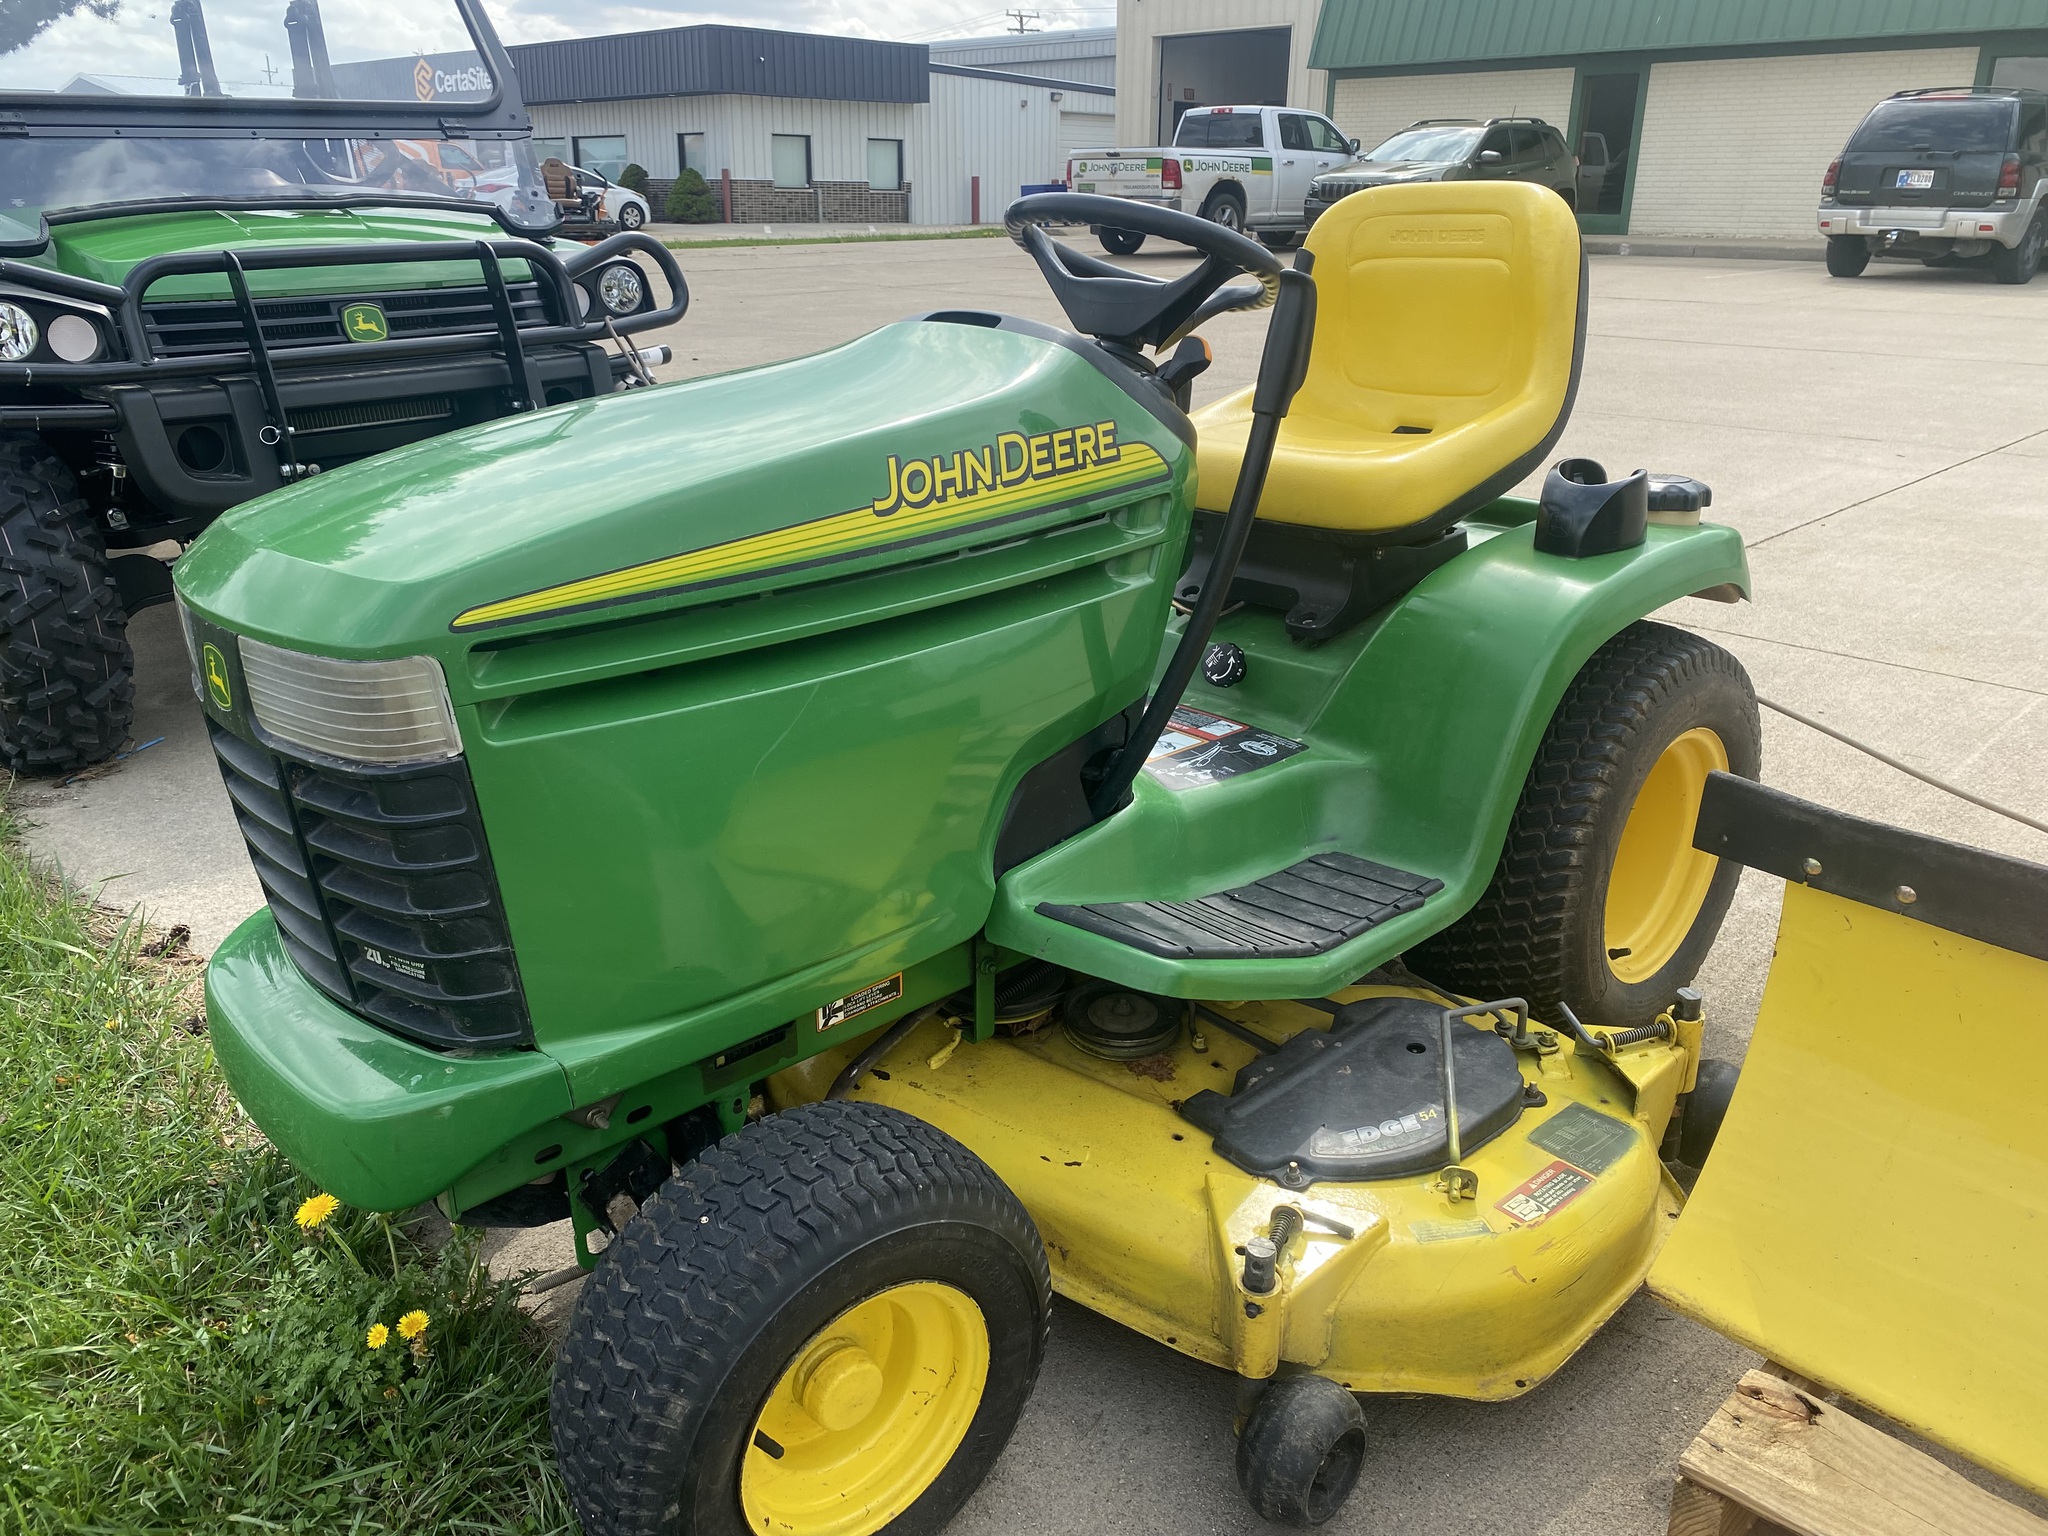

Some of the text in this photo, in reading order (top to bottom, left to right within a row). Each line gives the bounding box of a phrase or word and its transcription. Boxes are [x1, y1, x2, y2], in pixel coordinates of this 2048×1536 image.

[435, 66, 492, 93] CertaSite
[1088, 162, 1146, 172] JOHN DEERE
[1195, 160, 1250, 173] JOHN DEERE
[1389, 228, 1485, 244] JOHN DEERE
[873, 419, 1121, 517] JOHN DEERE
[851, 980, 891, 1001] LOADED SPRING
[844, 993, 883, 1012] FORWARD BEFORE
[845, 1005, 867, 1017] CHANGING
[1338, 1114, 1422, 1149] EDGE
[1418, 1108, 1438, 1122] 54
[1532, 1169, 1557, 1185] DANGER
[1533, 1172, 1568, 1197] ROTATING BLADE
